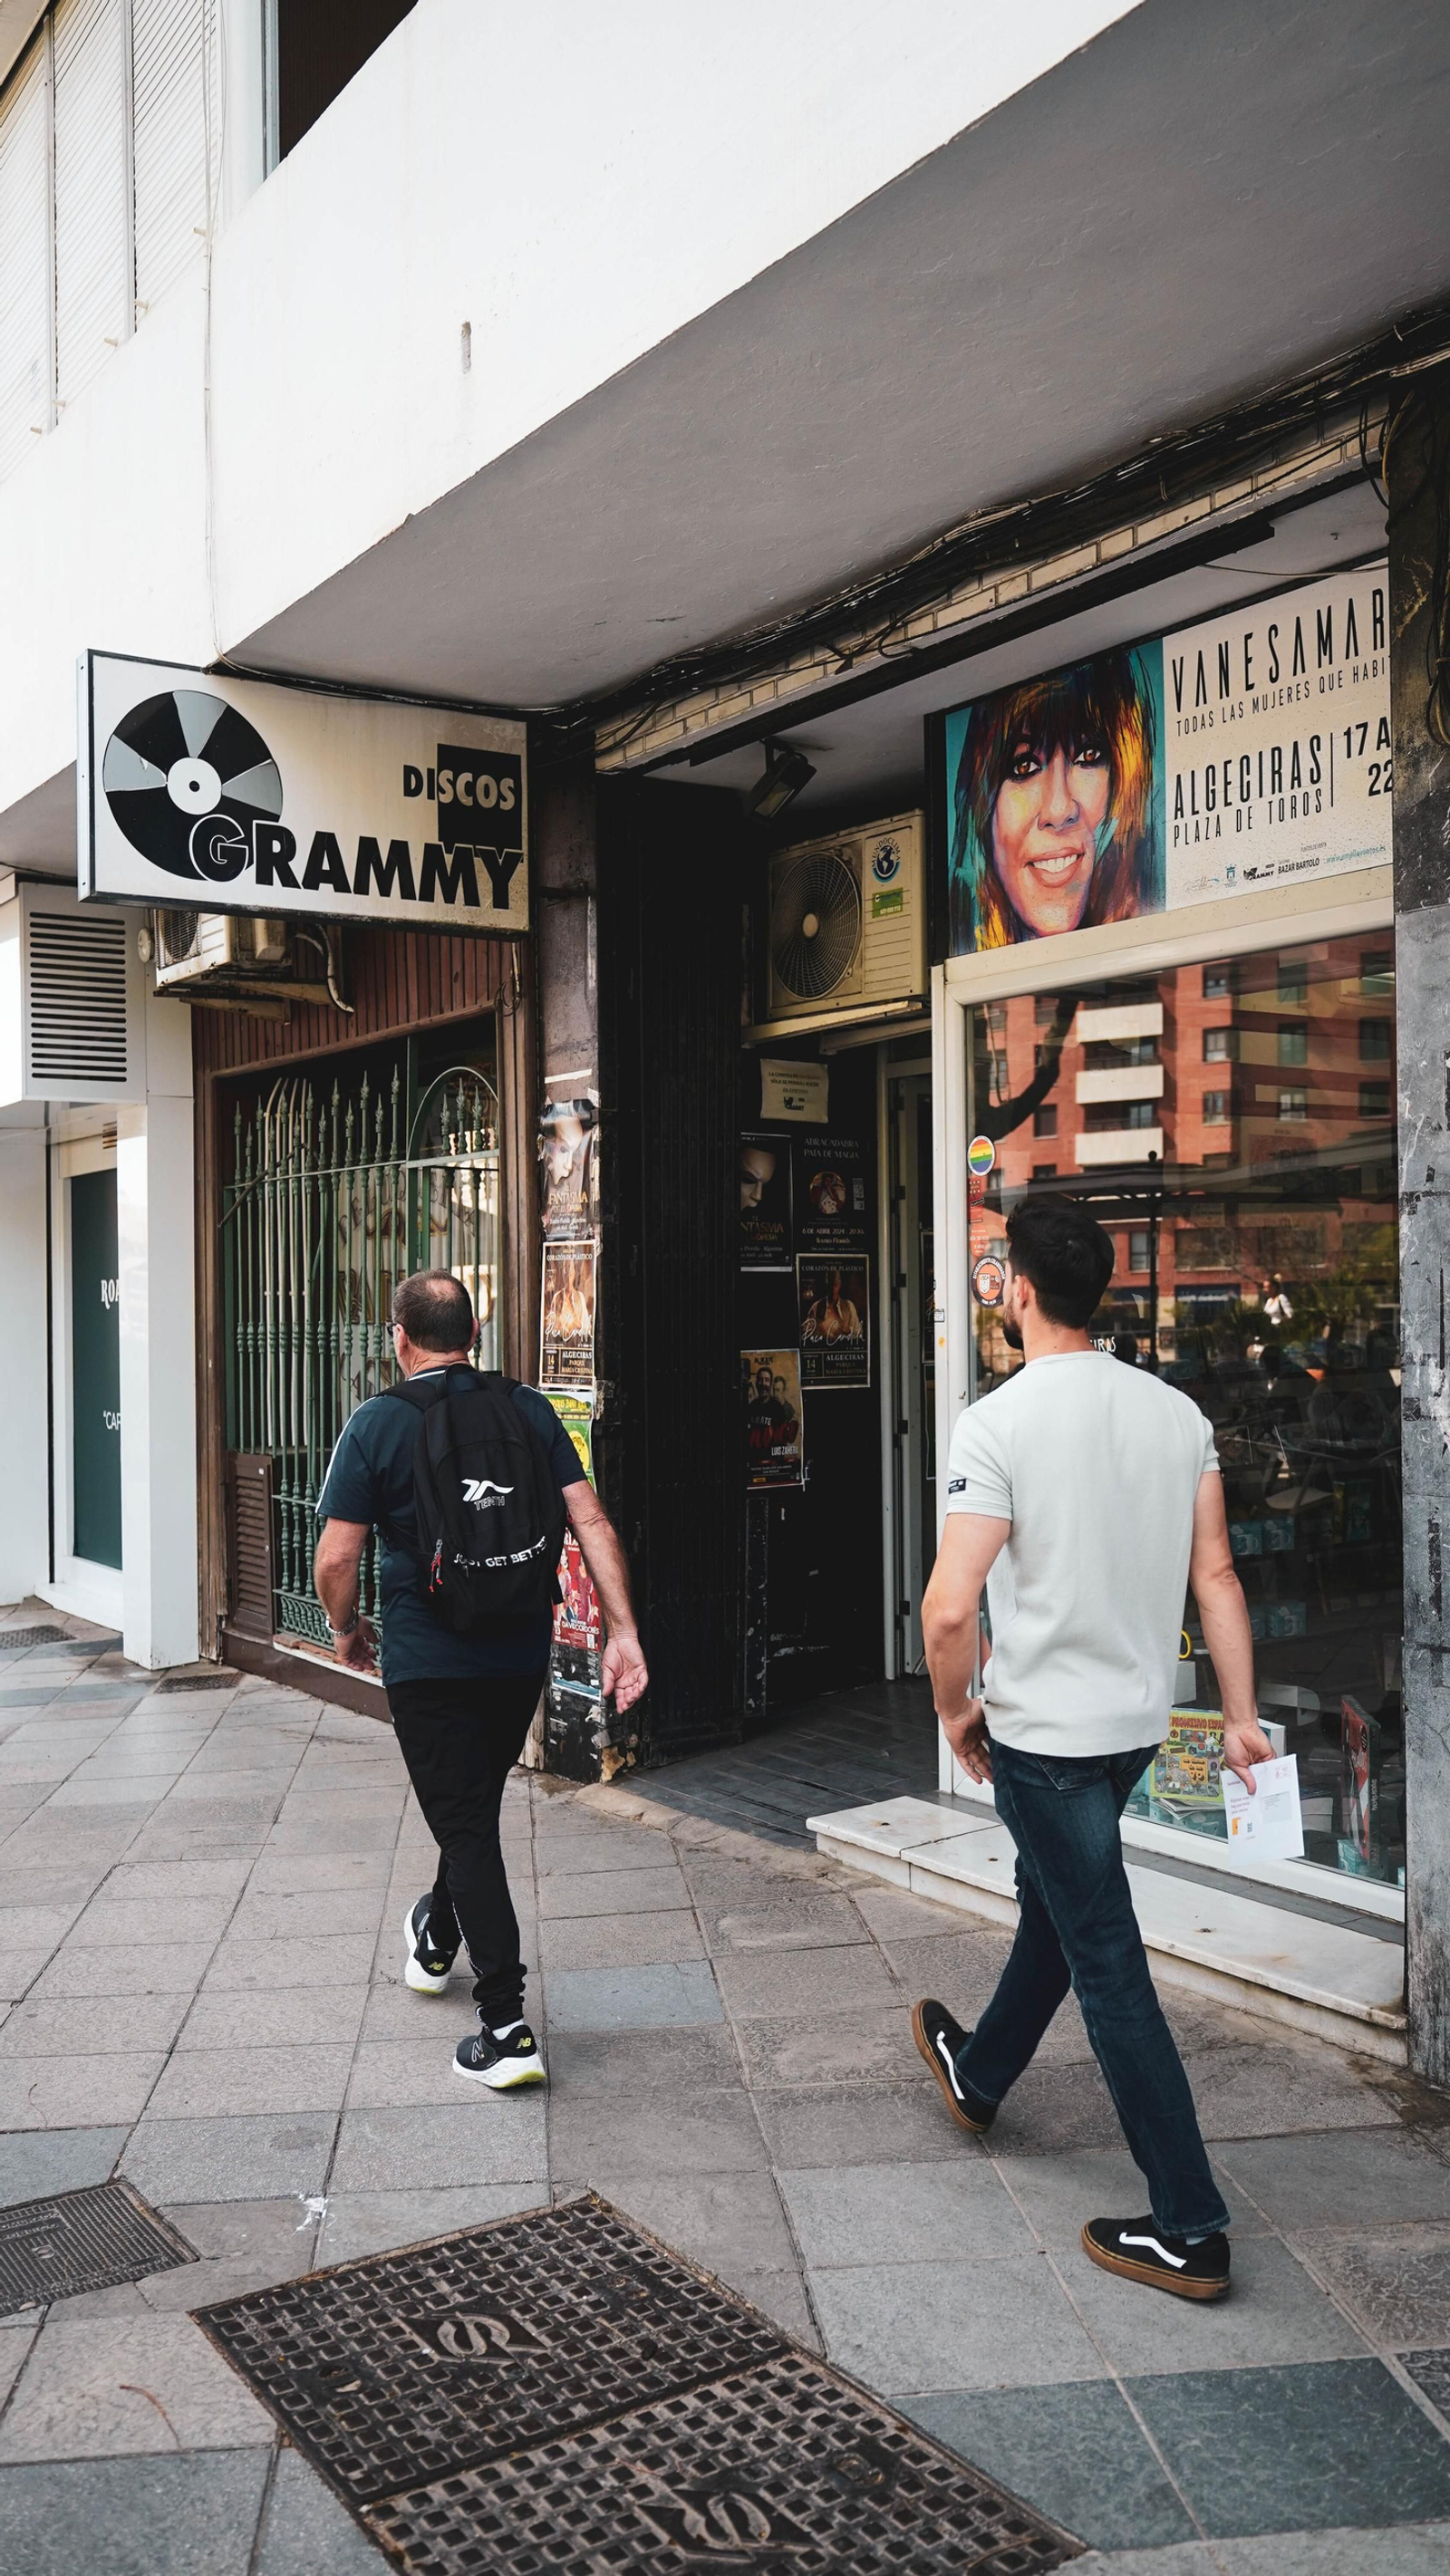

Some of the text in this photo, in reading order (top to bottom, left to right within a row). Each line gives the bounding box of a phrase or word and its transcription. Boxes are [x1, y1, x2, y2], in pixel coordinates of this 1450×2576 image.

[1176, 710, 1214, 737] TODAS
[1222, 701, 1244, 723] LAS
[1252, 681, 1310, 715] MUJERES
[1320, 670, 1344, 695] QUE
[1174, 735, 1322, 821] ALGECIRAS
[1343, 721, 1369, 759] 17
[403, 764, 516, 811] DISCOS
[1174, 787, 1322, 848] PLAZA DE TOROS
[871, 836, 901, 868] MUNDOCLIMA
[188, 814, 525, 911] GRAMMY
[1278, 862, 1295, 875] BAZAR
[1296, 858, 1320, 872] BARTOLO
[804, 1137, 860, 1148] ABRACADABRA
[823, 1150, 832, 1158] DE
[802, 1263, 830, 1272] CORAZÓN
[838, 1263, 865, 1272] PLÁSTICO
[562, 1350, 593, 1359] ALGECIRAS
[806, 1354, 865, 1369] 14 ALGECIRAS
[473, 1495, 506, 1511] TENTH
[485, 1556, 508, 1568] GET
[1172, 1715, 1207, 1729] PROGRESIVO
